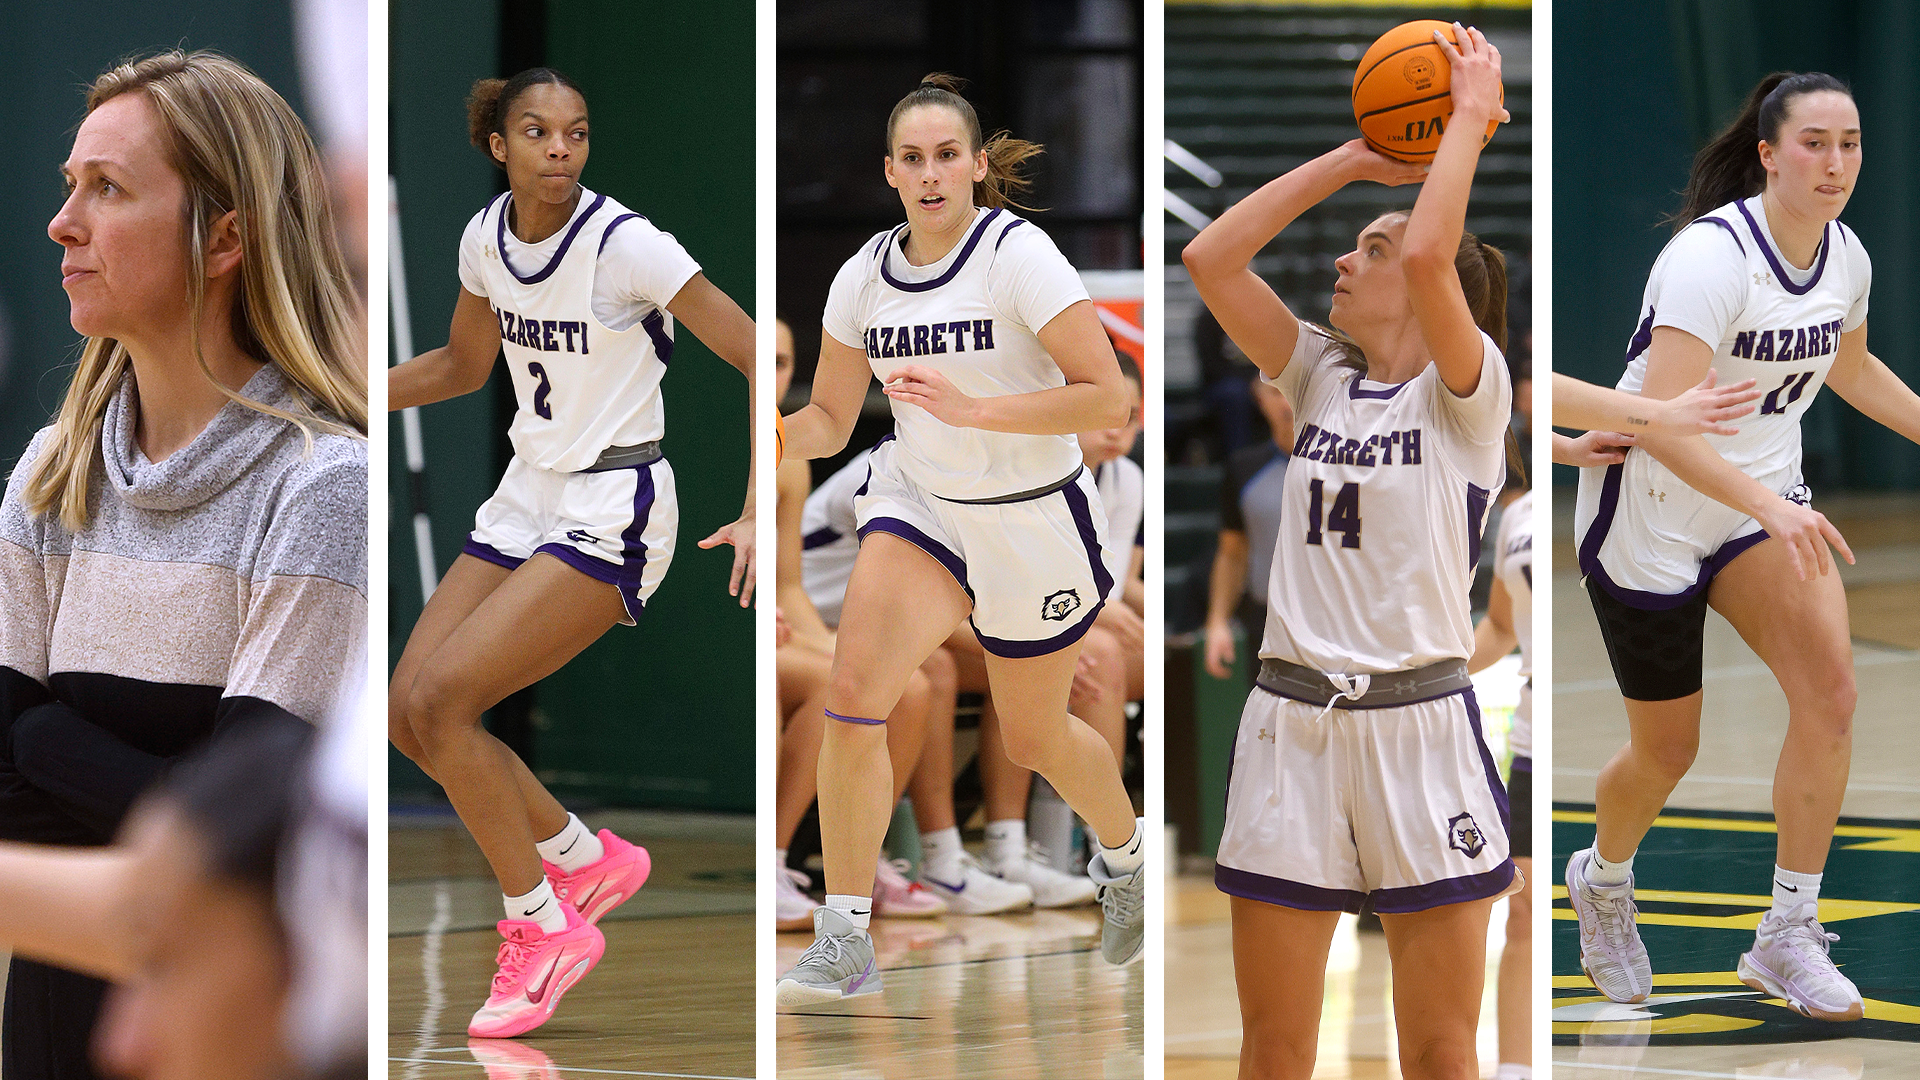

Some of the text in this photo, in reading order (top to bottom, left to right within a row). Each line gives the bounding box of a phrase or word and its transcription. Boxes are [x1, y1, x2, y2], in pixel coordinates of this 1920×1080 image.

[1405, 112, 1454, 142] VO
[1730, 317, 1843, 362] NAZARET
[527, 361, 552, 421] 2
[1760, 370, 1816, 415] 11
[1305, 477, 1362, 550] 14
